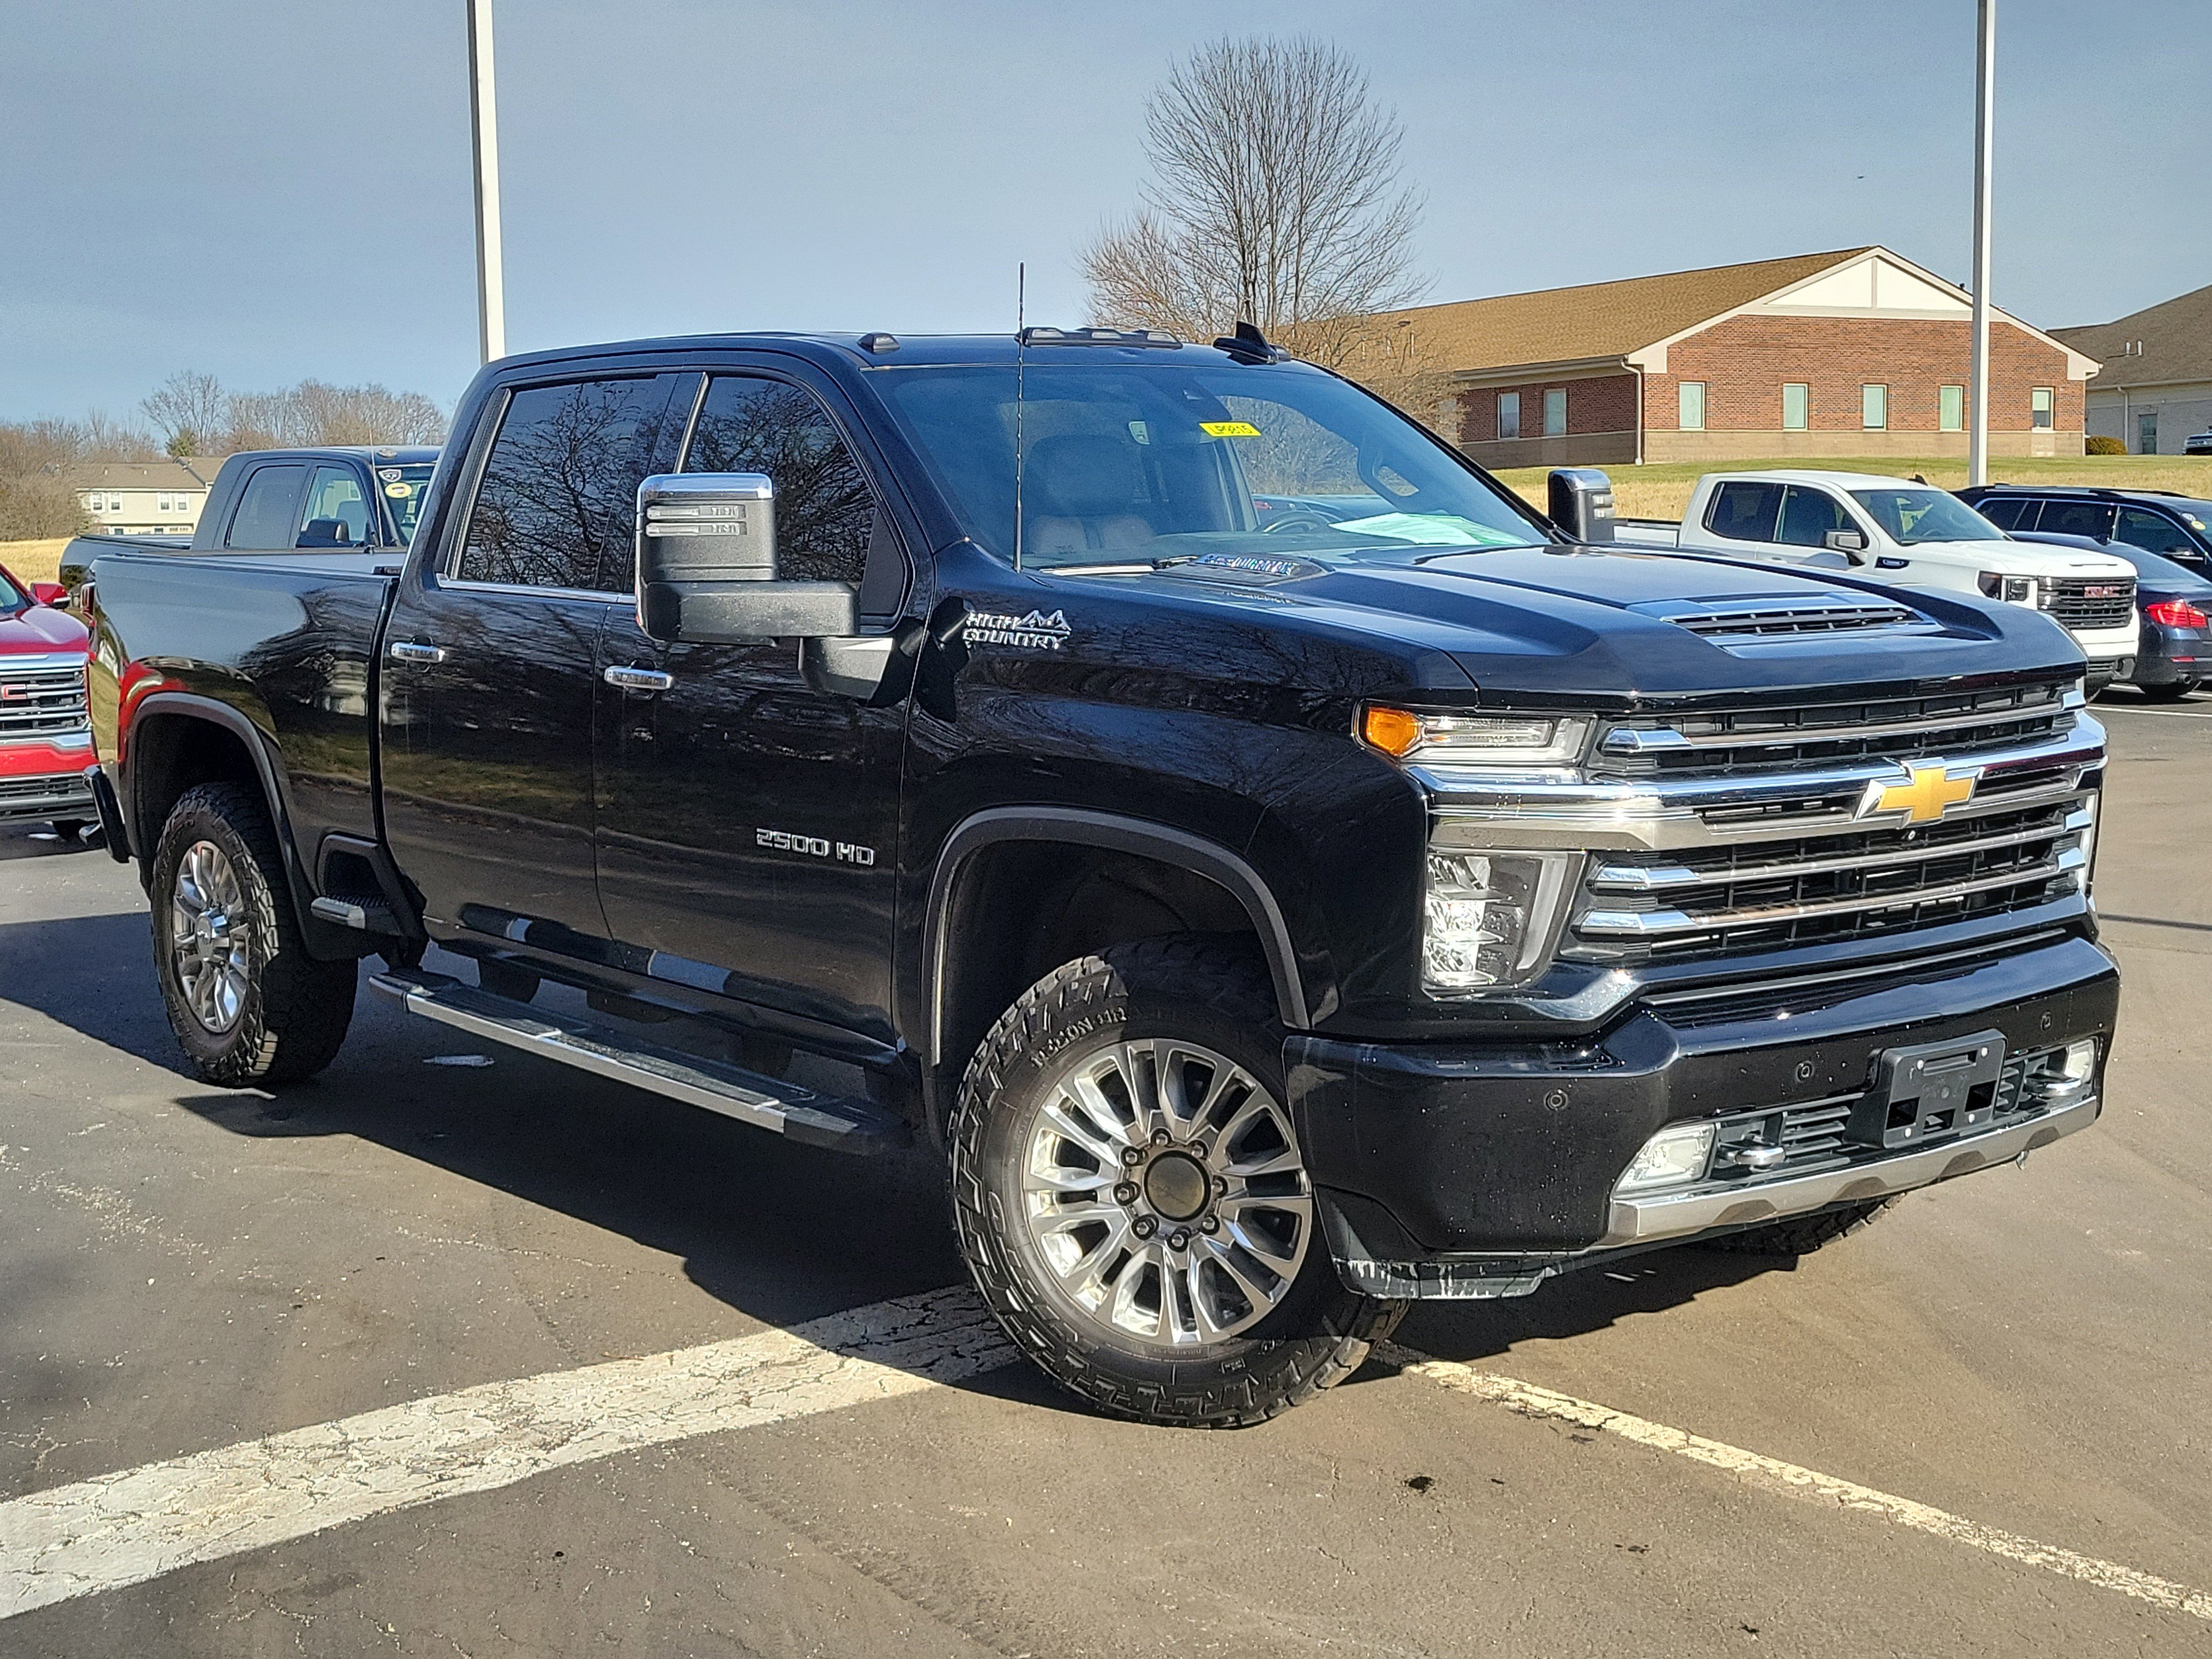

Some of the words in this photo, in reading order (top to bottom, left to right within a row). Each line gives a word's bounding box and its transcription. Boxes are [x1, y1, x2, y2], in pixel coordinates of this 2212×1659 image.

[966, 612, 1022, 630] HIGH
[962, 628, 1068, 650] COUNTRY
[756, 827, 829, 857] 2500
[836, 842, 874, 866] HD
